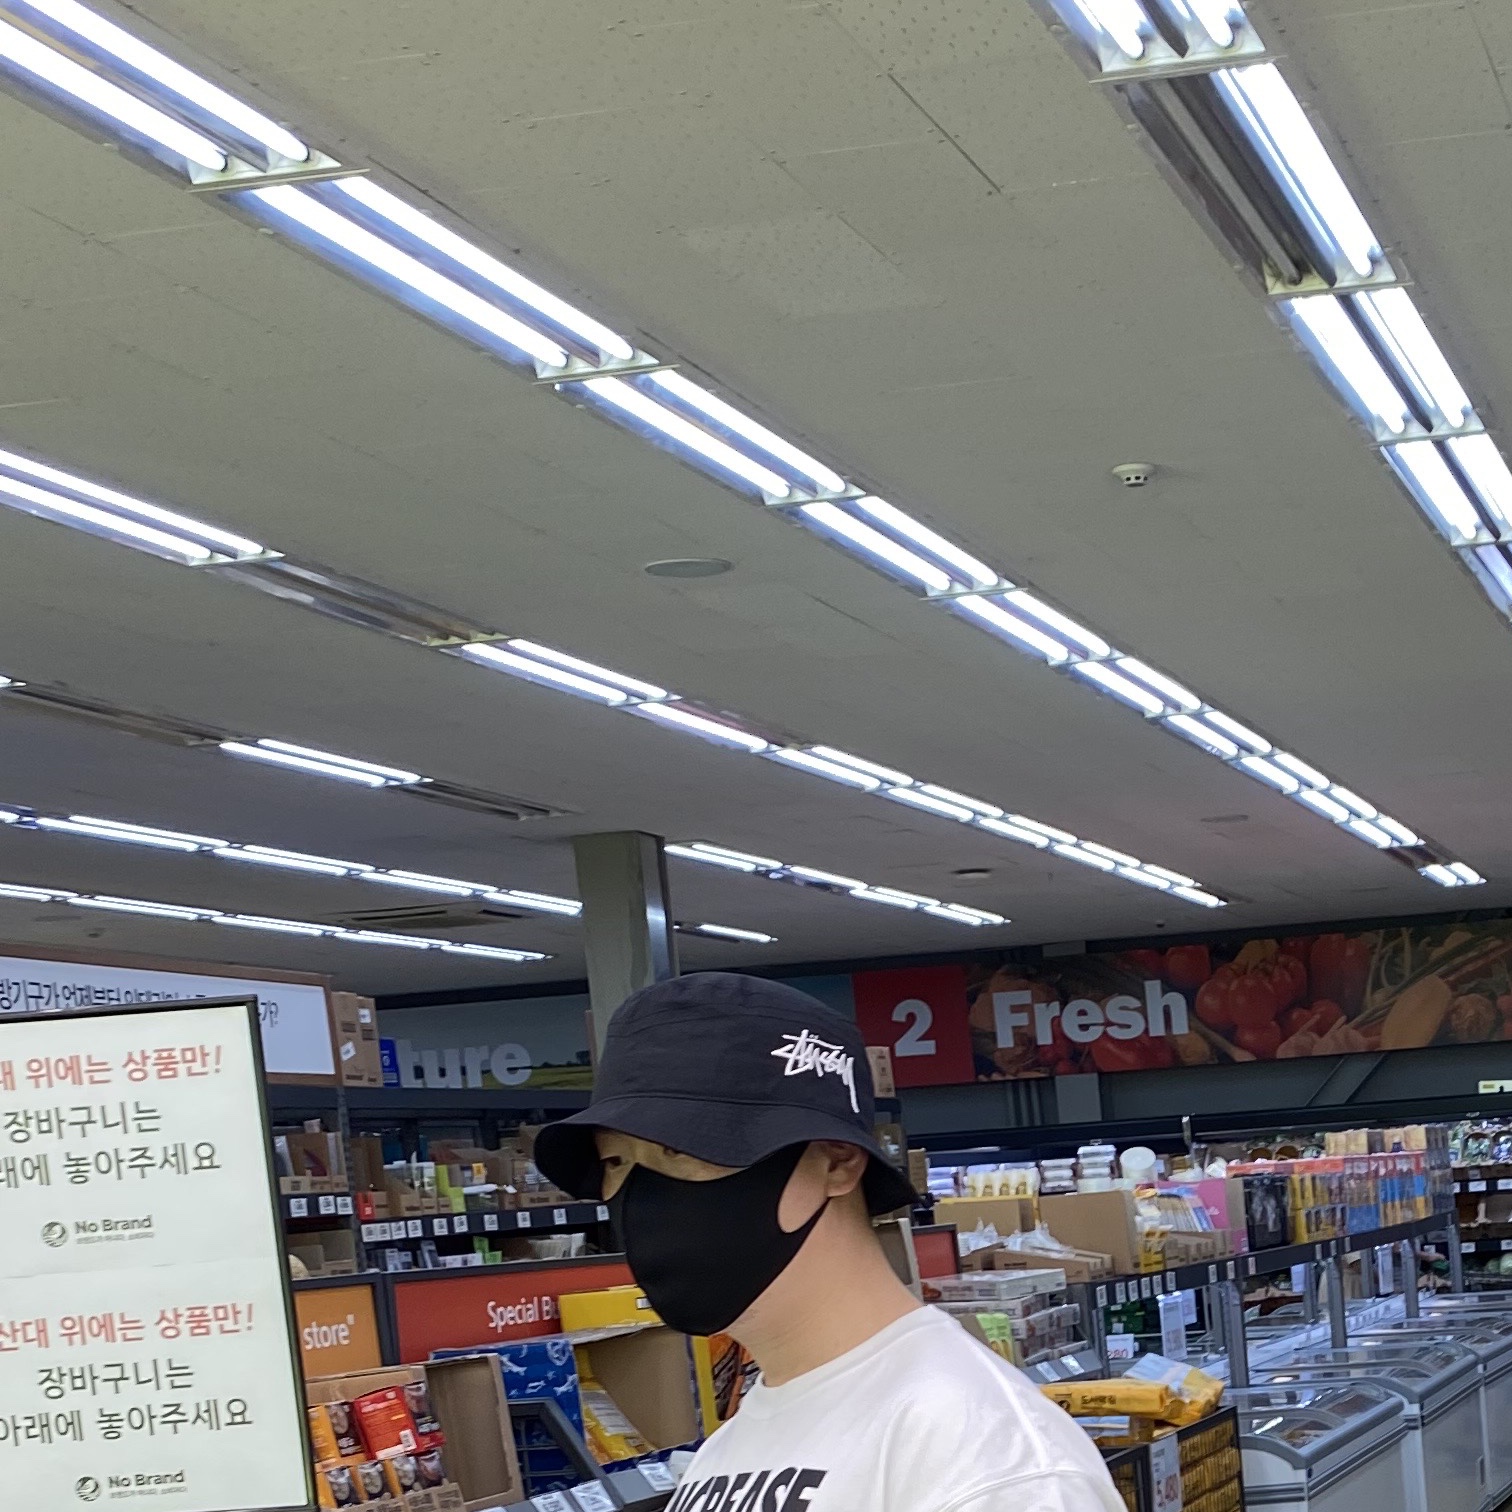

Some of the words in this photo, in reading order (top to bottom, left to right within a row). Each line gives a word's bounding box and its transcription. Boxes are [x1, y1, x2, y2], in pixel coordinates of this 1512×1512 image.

[259, 1000, 279, 1028] 가?
[891, 999, 936, 1057] 2
[992, 980, 1189, 1049] Fresh
[26, 1053, 113, 1089] 위에는
[122, 1044, 223, 1083] 상품만!
[401, 1040, 532, 1088] ture
[3, 1100, 162, 1143] 장바구니는
[63, 1141, 222, 1186] 놓아주세요
[75, 1219, 98, 1234] No
[103, 1214, 153, 1233] Brand
[59, 1311, 145, 1347] 위에는
[155, 1302, 254, 1340] 상품만!
[487, 1296, 539, 1333] Special
[541, 1296, 559, 1320] Bu
[37, 1358, 195, 1400] 장바구니는
[0, 1409, 84, 1446] 아래에
[97, 1398, 253, 1440] 놓아주세요
[108, 1474, 132, 1489] No
[135, 1469, 185, 1486] Brand
